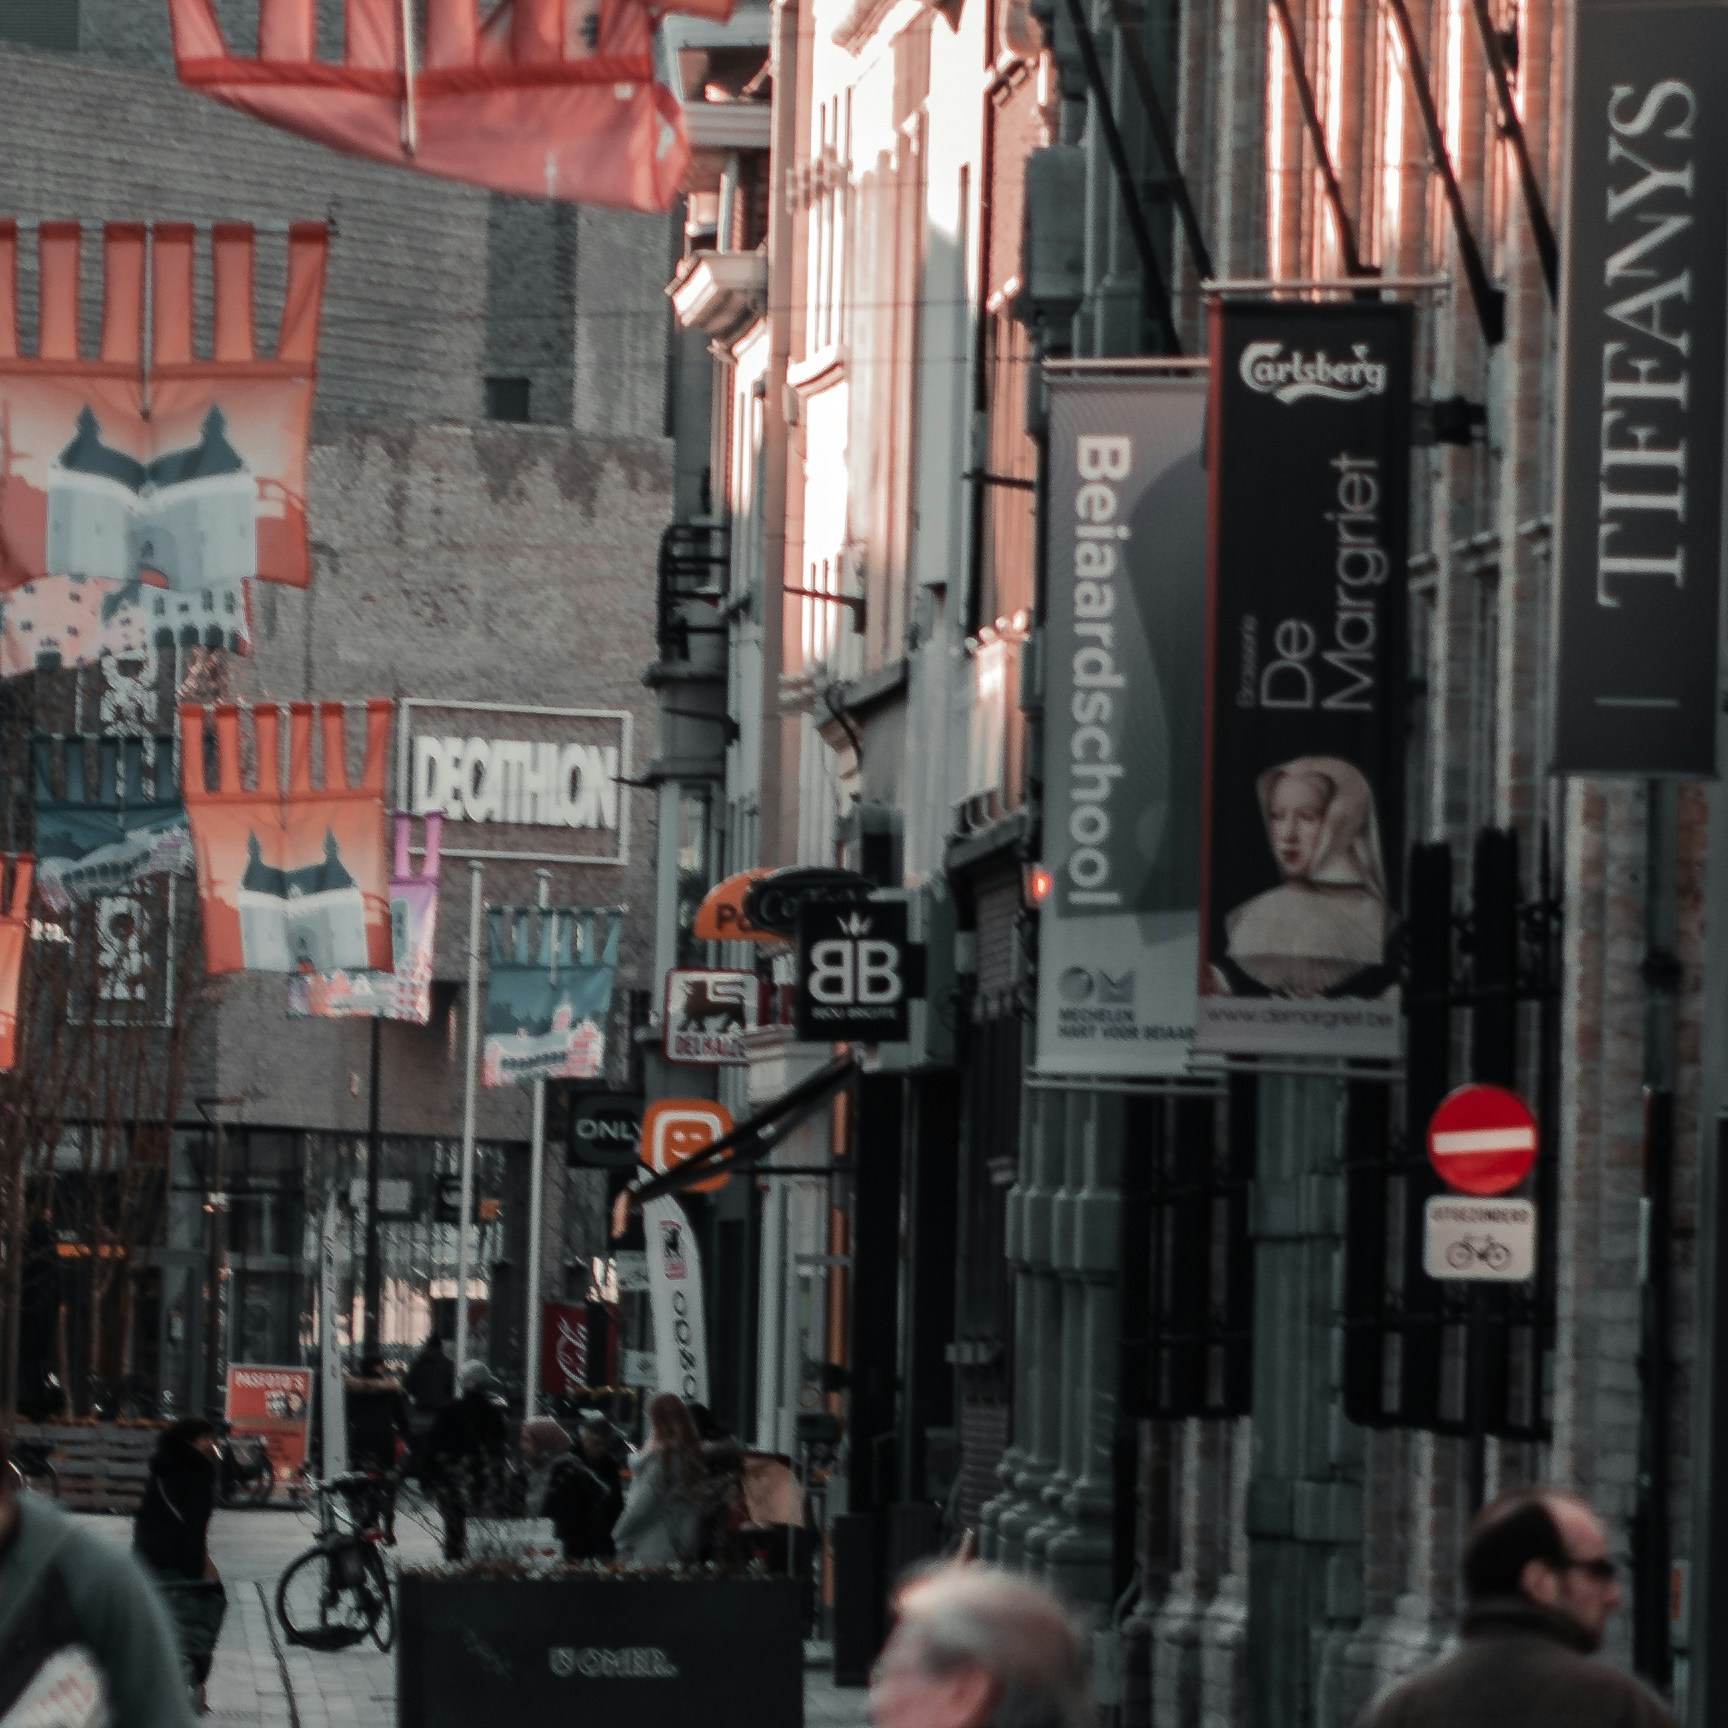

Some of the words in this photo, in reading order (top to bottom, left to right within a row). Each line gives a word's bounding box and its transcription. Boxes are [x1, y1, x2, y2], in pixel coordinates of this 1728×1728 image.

[1239, 341, 1388, 399] Carlsberg
[1595, 78, 1699, 610] TIFFANYS
[1069, 435, 1133, 906] Beiaardschool
[1259, 616, 1317, 711] De
[1320, 451, 1390, 712] Margriet
[412, 735, 619, 830] DECATHLON
